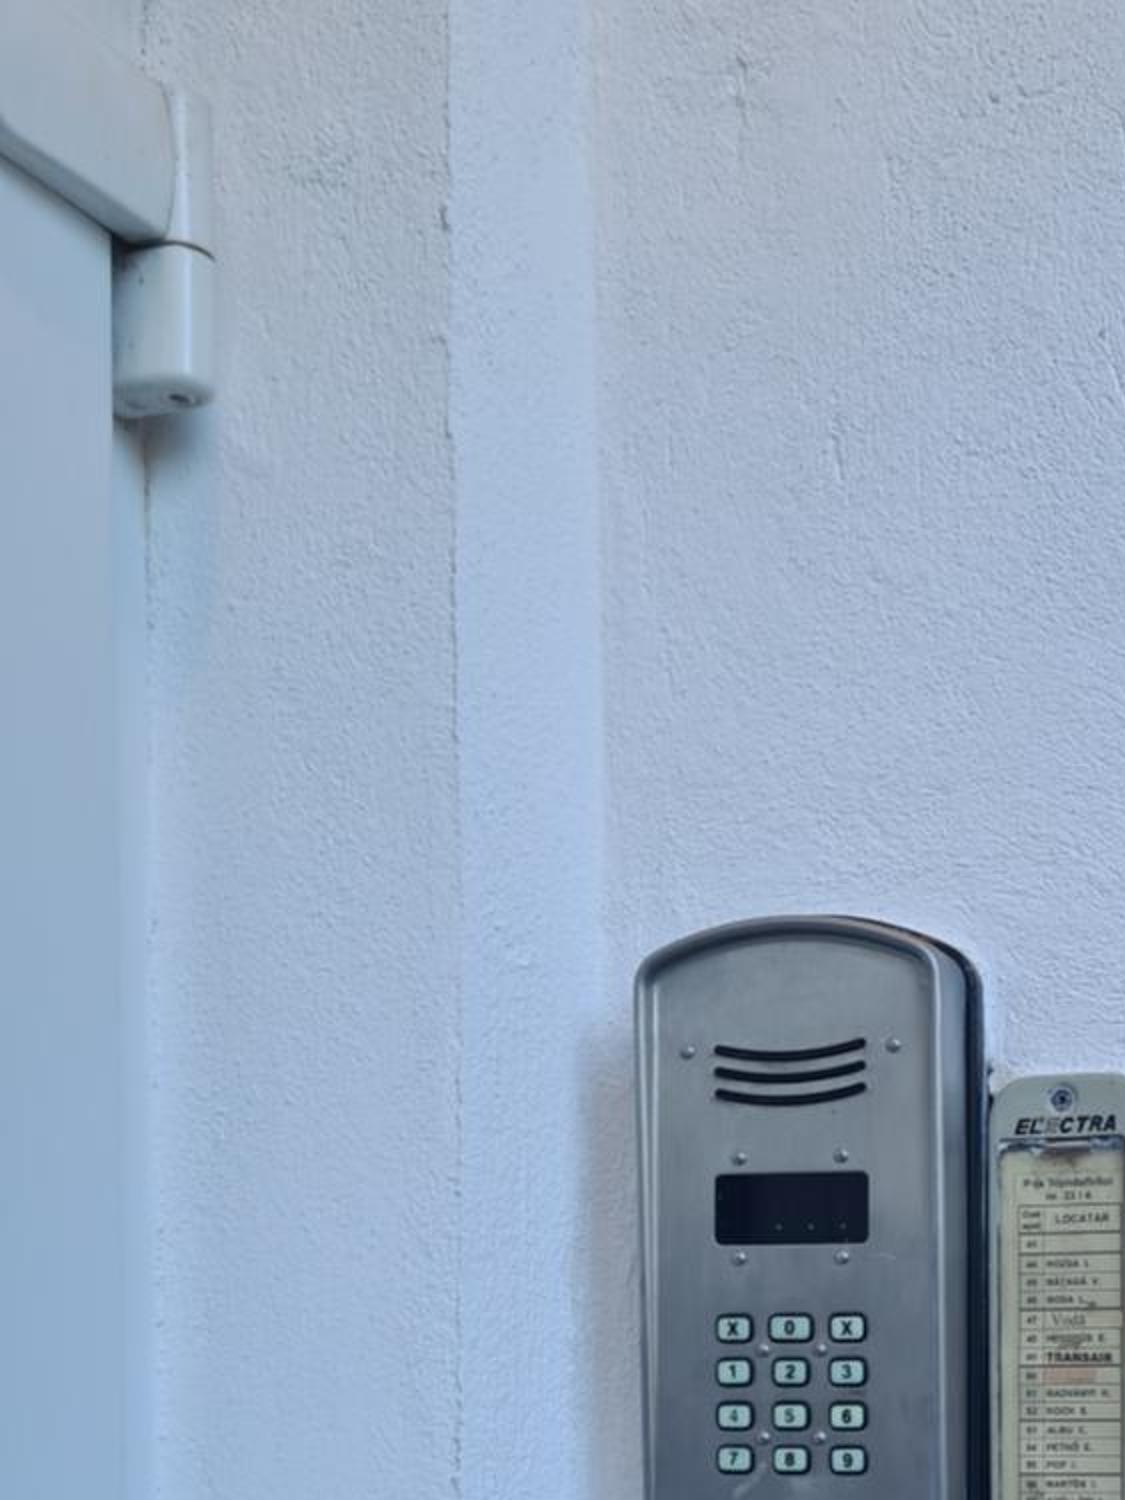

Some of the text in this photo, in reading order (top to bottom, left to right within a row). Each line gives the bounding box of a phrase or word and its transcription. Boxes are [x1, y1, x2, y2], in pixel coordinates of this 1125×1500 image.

[783, 1320, 795, 1335] 0
[728, 1365, 852, 1379] 1 2 3
[728, 1409, 852, 1423] 4 5 6
[728, 1452, 853, 1468] 7 8 9
